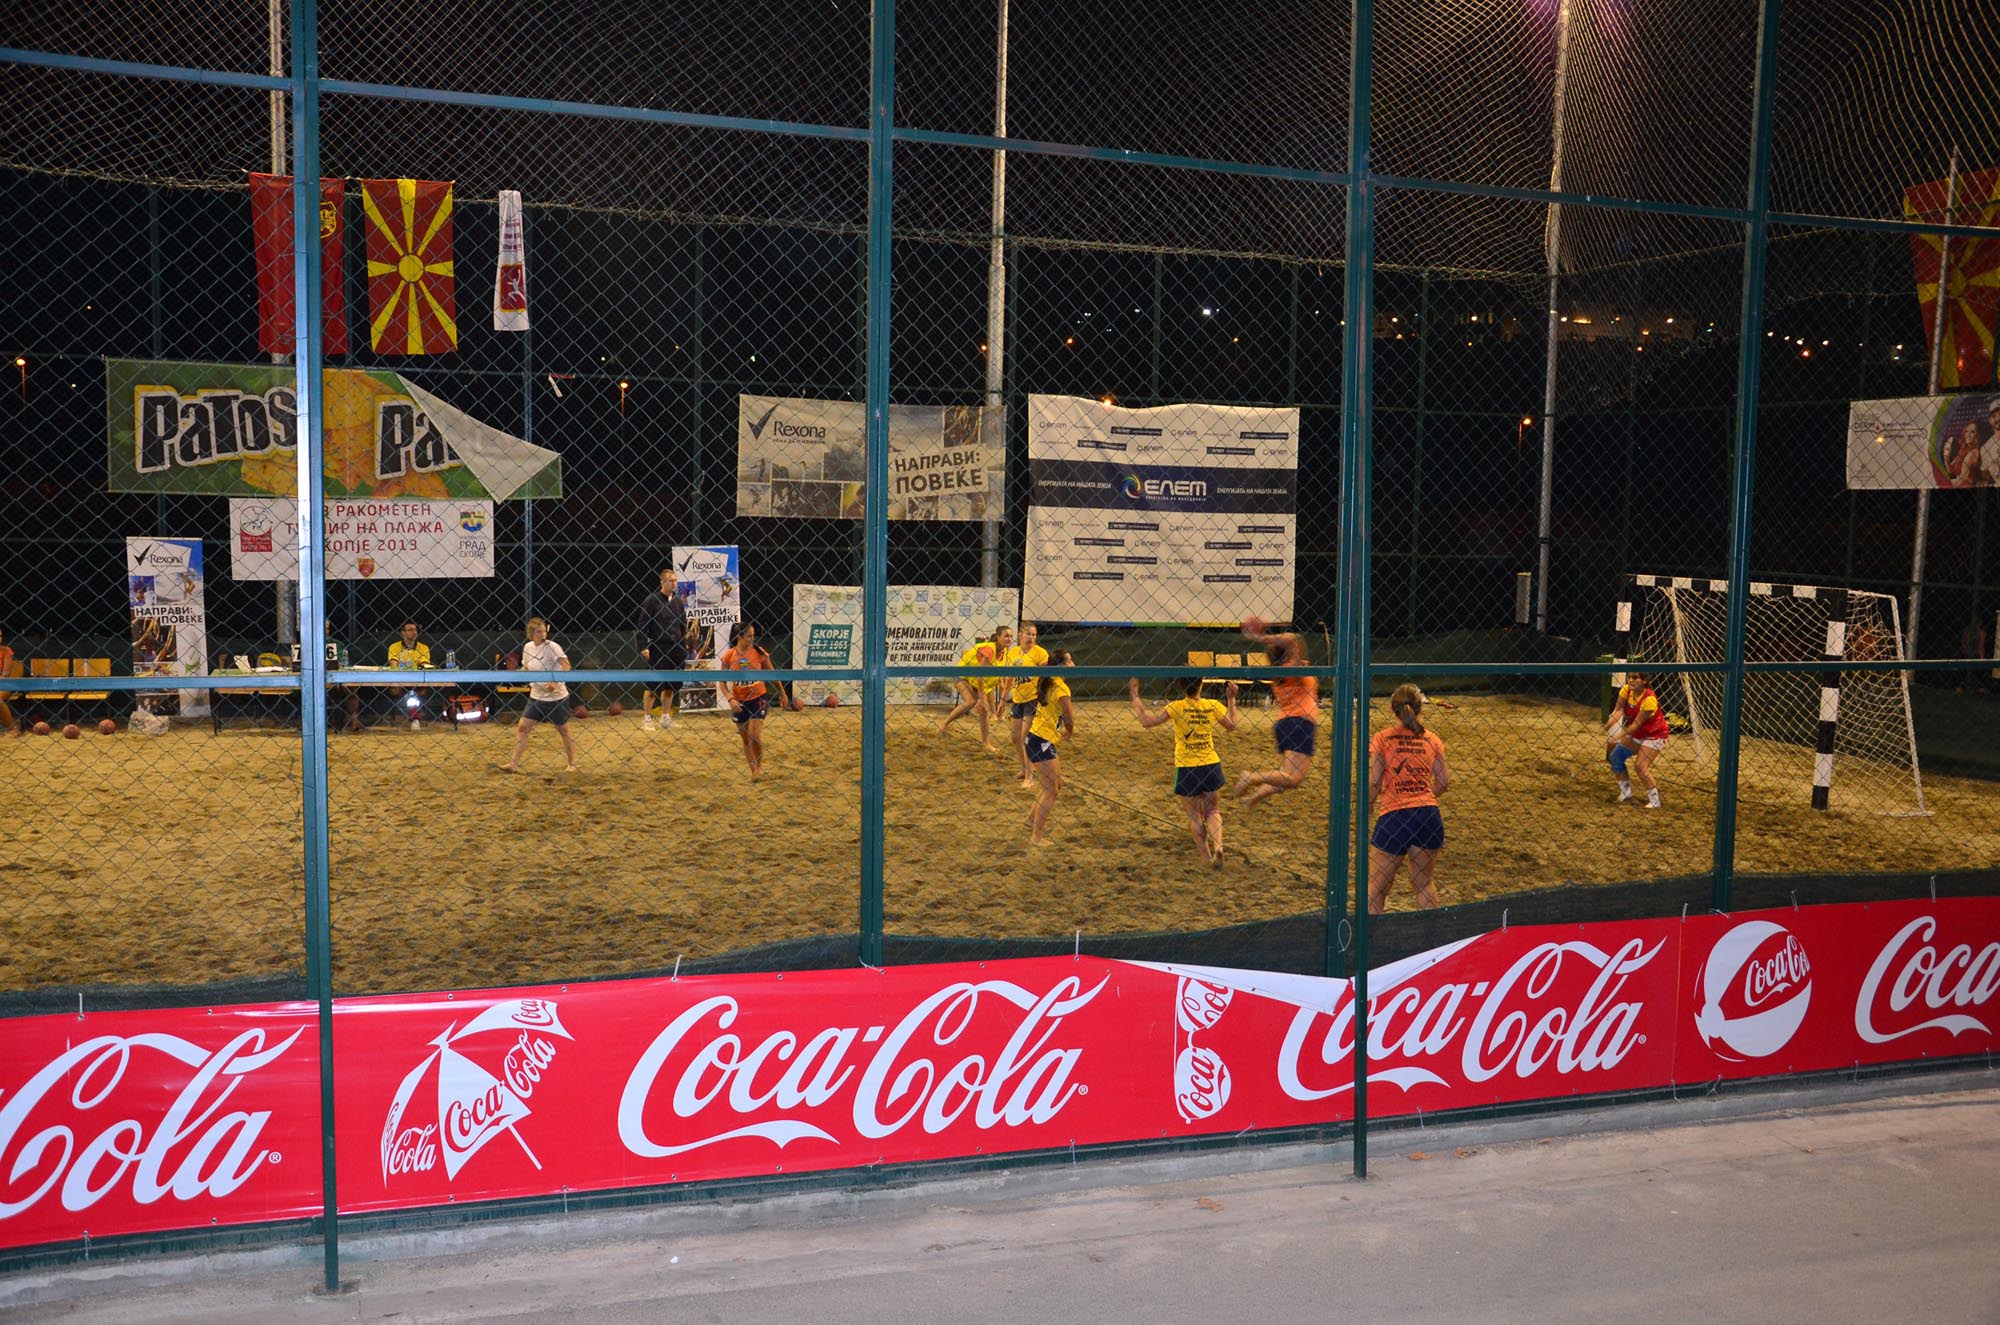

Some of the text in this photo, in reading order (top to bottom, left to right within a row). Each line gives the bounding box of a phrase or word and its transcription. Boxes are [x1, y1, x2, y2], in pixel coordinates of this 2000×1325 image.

[774, 421, 826, 438] Rexona
[376, 400, 463, 479] Pa
[336, 504, 432, 517] РАКОМЕТЕН
[286, 521, 443, 535] ТИР НА ПЛАЖА
[324, 539, 418, 553] КОПЈЕ 2013
[150, 553, 184, 564] Rexona
[692, 561, 722, 569] Rexona
[687, 608, 730, 618] АПРАВИ:
[813, 629, 850, 639] SKOPJE
[884, 627, 962, 639] MEMORATION OF
[889, 654, 953, 662] OF THE EARTHQUAKE
[0, 1024, 306, 1219] Cola
